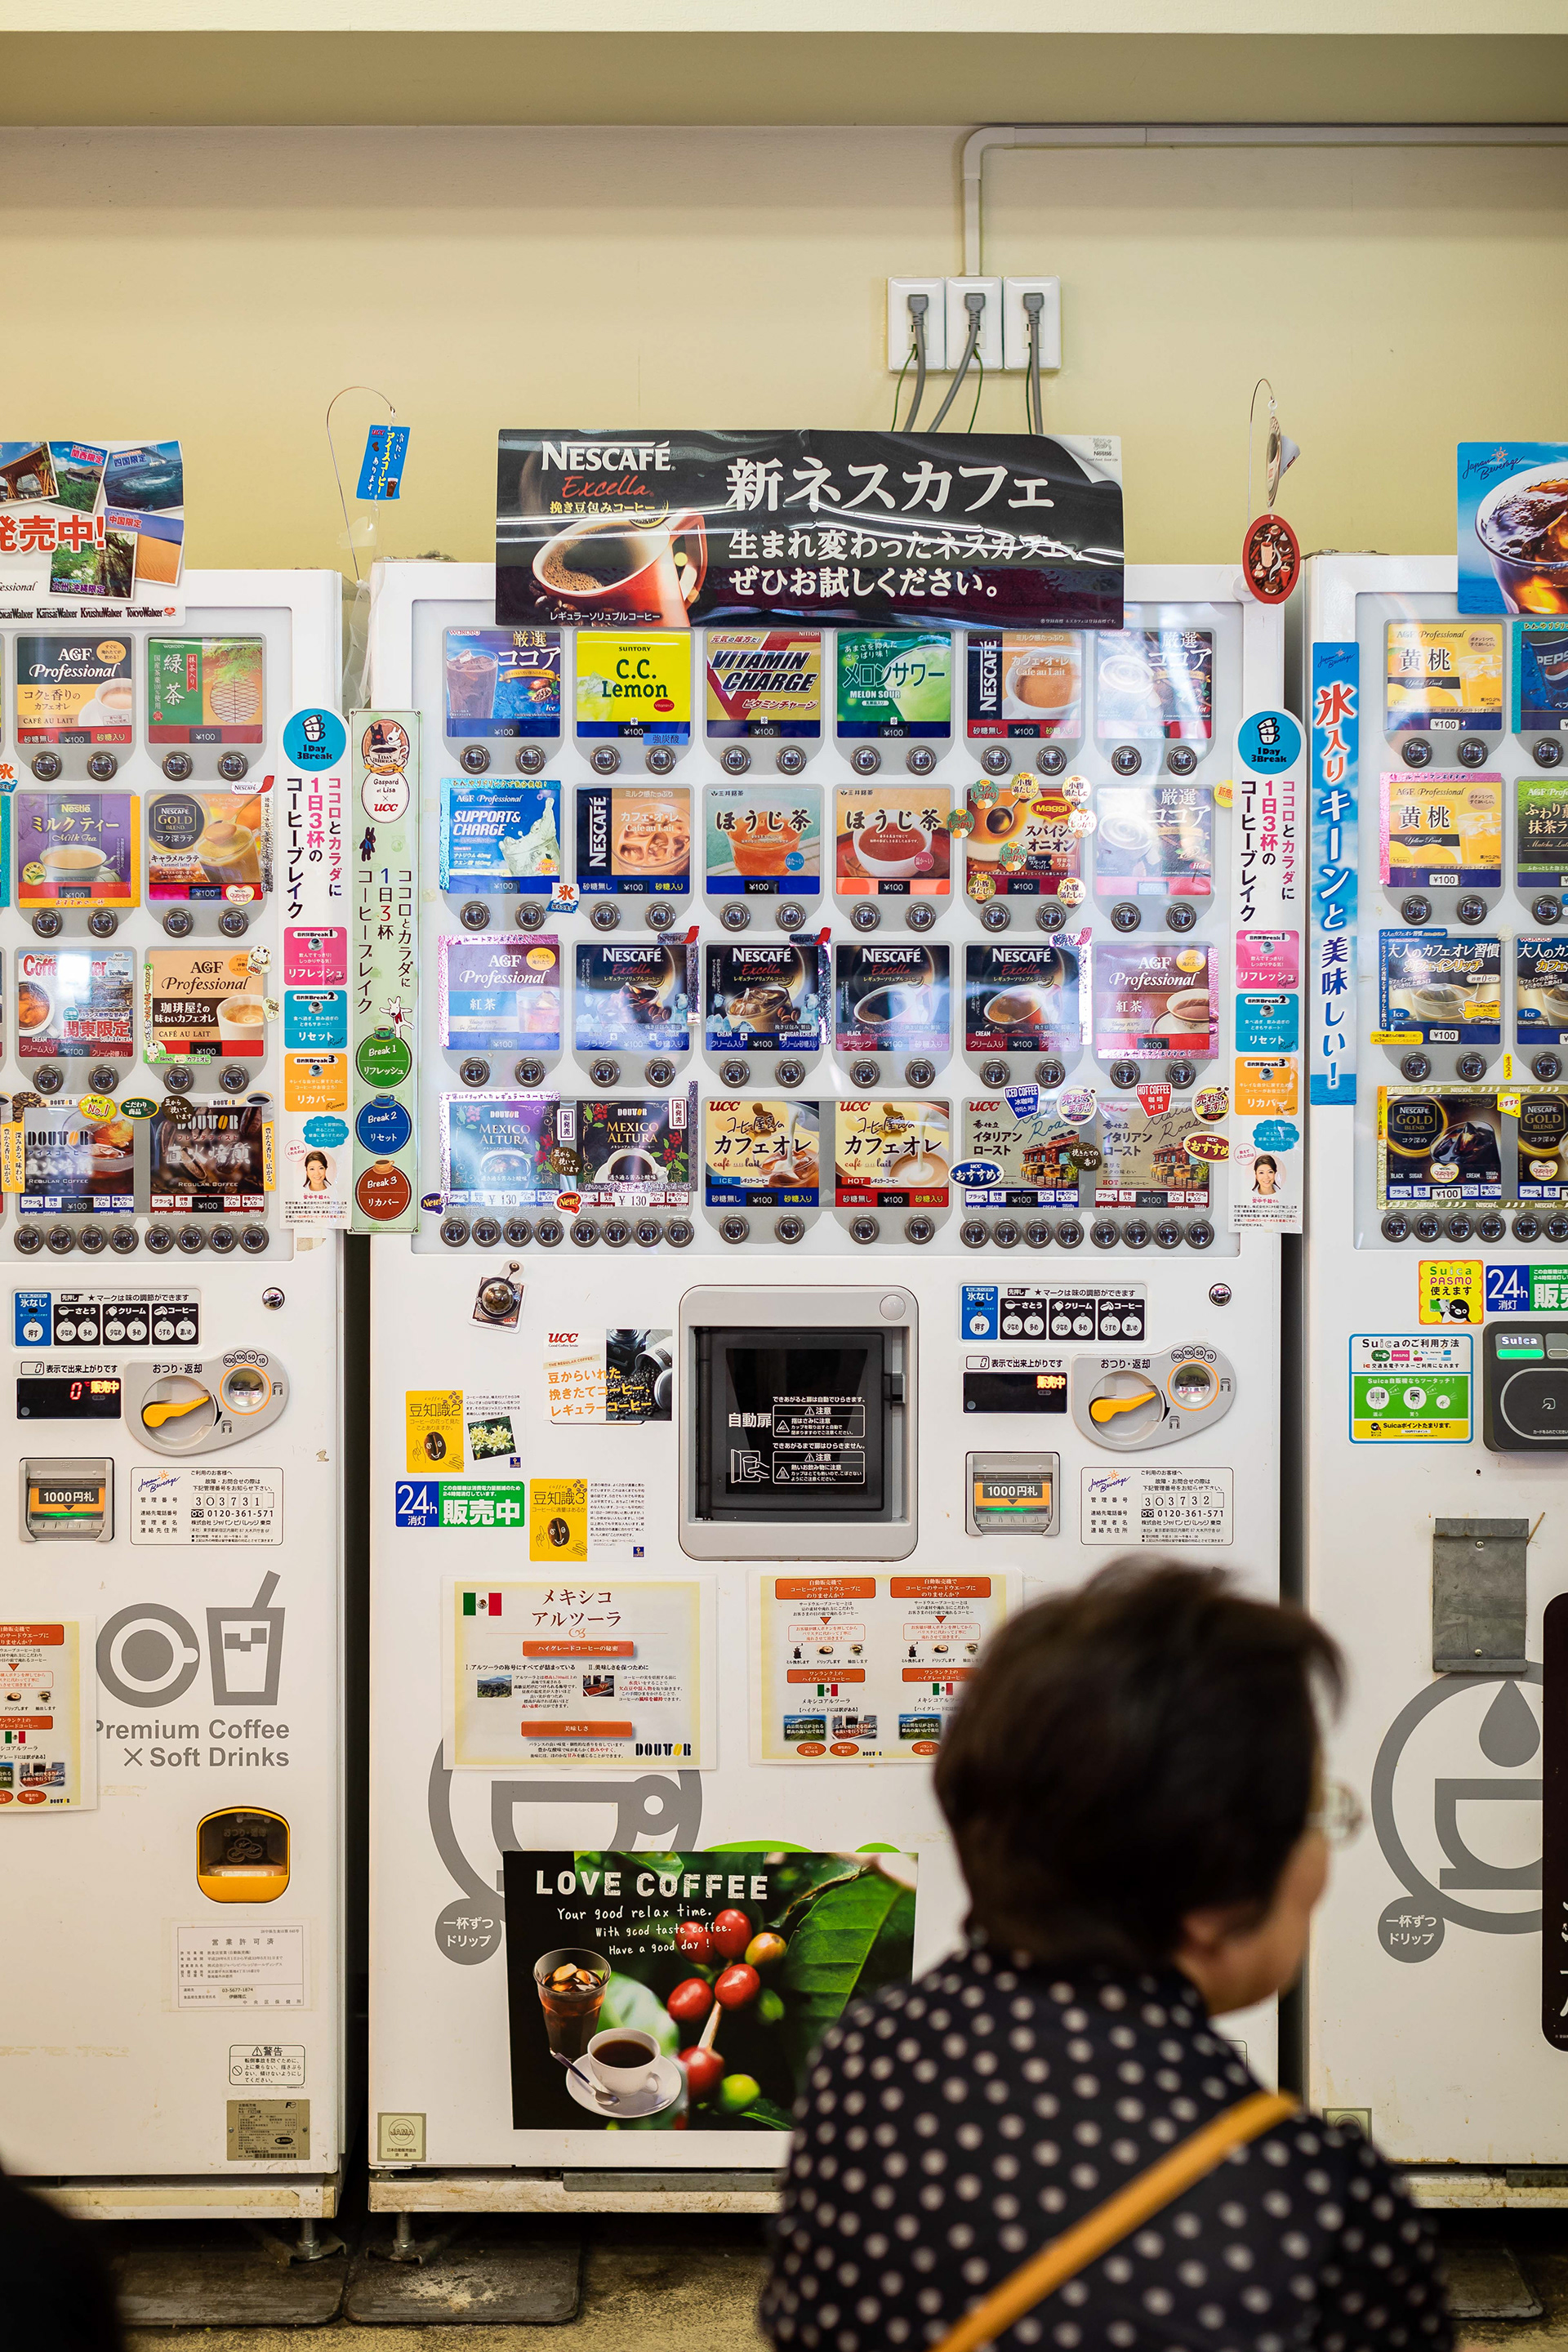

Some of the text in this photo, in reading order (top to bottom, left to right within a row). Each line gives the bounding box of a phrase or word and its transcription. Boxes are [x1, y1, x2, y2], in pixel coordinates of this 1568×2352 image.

[70, 450, 104, 465] 関西限定
[114, 453, 147, 466] 四国限定
[378, 432, 395, 493] アイスコーヒー
[562, 476, 651, 498] Excella
[726, 457, 1055, 513] 新ネスカフェ
[109, 516, 142, 528] 中国限定
[729, 568, 998, 599] ぜひお試しください。
[550, 611, 660, 621] レギュラーソリュブルコーヒー
[512, 631, 547, 648] 厳選
[498, 648, 560, 669] ココア
[710, 650, 810, 670] VITAMIN
[1401, 648, 1451, 672] 黄桃
[29, 663, 119, 681] Professional
[616, 659, 657, 679] C.C.
[843, 663, 946, 687] メロンサワー
[602, 680, 668, 697] Lemon
[722, 672, 818, 692] CHARGE
[33, 702, 70, 710] カフェオレ
[742, 699, 817, 710] ビタミンチャージ
[1434, 720, 1456, 728] ¥100
[973, 727, 1003, 735] 砂糖無し
[1036, 804, 1068, 813] Maggi
[158, 815, 193, 826] GOLD
[307, 778, 325, 862] 1日3杯の
[454, 811, 520, 823] SUPPORT&
[715, 809, 813, 831] ほうじ茶
[845, 809, 942, 831] ほうじ茶
[1147, 805, 1210, 826] ココア
[1399, 805, 1450, 830] 黄桃
[31, 817, 119, 831] ミルクティー
[453, 823, 506, 836] CHARGE
[328, 778, 342, 897] ココロとカラダに
[287, 778, 304, 919] コーヒーブレイク
[1027, 840, 1076, 853] オニオン
[151, 854, 199, 862] キャラメルラテ
[749, 883, 768, 891] ¥100
[1013, 882, 1033, 890] ¥100
[377, 867, 394, 941] 1日3杯
[398, 870, 414, 988] ココロとカラダに
[357, 870, 374, 1015] コーヒーブレイク
[742, 964, 782, 974] Excella
[1405, 959, 1483, 972] カフェインリッチ
[288, 968, 343, 978] リフレッシュ
[460, 969, 548, 985] Professional
[161, 976, 251, 993] Professional
[470, 998, 497, 1010] 紅茶
[1116, 1001, 1142, 1013] 紅茶
[155, 1013, 216, 1023] 味わいカフェオレ
[63, 1021, 130, 1038] 関東限定
[298, 1031, 334, 1041] リセット
[1434, 1031, 1455, 1040] ¥100
[364, 1066, 403, 1075] リフレッシュ
[1138, 1085, 1170, 1094] HOT COFFEE
[296, 1095, 336, 1104] リカバー
[1396, 1114, 1433, 1125] GOLD
[607, 1122, 658, 1134] MEXICO
[27, 1131, 89, 1146] DOUTOR
[371, 1132, 397, 1142] リセット
[607, 1132, 657, 1144] ALTURA
[973, 1132, 1022, 1142] イタリアン
[714, 1135, 811, 1156] カフェオレ
[844, 1135, 942, 1156] カフェオレ
[974, 1145, 1011, 1156] ロースト
[752, 1196, 772, 1204] ¥100
[915, 1195, 943, 1204] 砂糖入り
[1437, 1190, 1458, 1198] ¥100
[1430, 1267, 1472, 1275] Suica
[1430, 1276, 1472, 1285] PASMO
[1431, 1286, 1472, 1295] 使えます
[20, 1299, 47, 1307] 氷なし
[1499, 1300, 1517, 1310] 消灯
[1362, 1339, 1459, 1348] Suicaのご利用方法
[1501, 1336, 1537, 1345] Suica
[46, 1365, 118, 1374] 表示で出来上がりです
[153, 1364, 203, 1374] おつり・返却
[547, 1367, 621, 1384] 豆からいれた
[91, 1381, 119, 1393] 販売中
[549, 1384, 651, 1401] 挽きたてコーヒー、
[409, 1404, 461, 1417] 豆知識2
[550, 1401, 652, 1417] レギュラーコーヒー
[728, 1413, 772, 1428] 自動扉
[533, 1491, 585, 1504] 豆知識3
[987, 1486, 1038, 1497] 1000円札
[443, 1499, 521, 1526] 販売中
[408, 1516, 425, 1526] 消灯
[542, 1588, 612, 1606] メキシコ
[532, 1612, 622, 1628] アルツーラ
[209, 1720, 289, 1739] Coffee
[635, 1743, 692, 1756] DOUTOR
[150, 1748, 200, 1766] Soft
[209, 1748, 289, 1766] Drinks
[536, 1870, 768, 1900] LOVE COFFEE
[557, 1904, 712, 1921] Your good relax time.
[443, 1918, 494, 1930] 一杯ずつ
[1385, 1914, 1437, 1928] 一杯ずつ
[595, 1926, 620, 1937] With
[655, 1924, 686, 1936] taste
[692, 1922, 732, 1935] coffee.
[446, 1936, 492, 1947] ドリップ
[1388, 1933, 1435, 1945] ドリップ
[608, 1944, 633, 1955] Have
[651, 1943, 675, 1953] good
[680, 1940, 700, 1953] day
[264, 2047, 283, 2056] 警告
